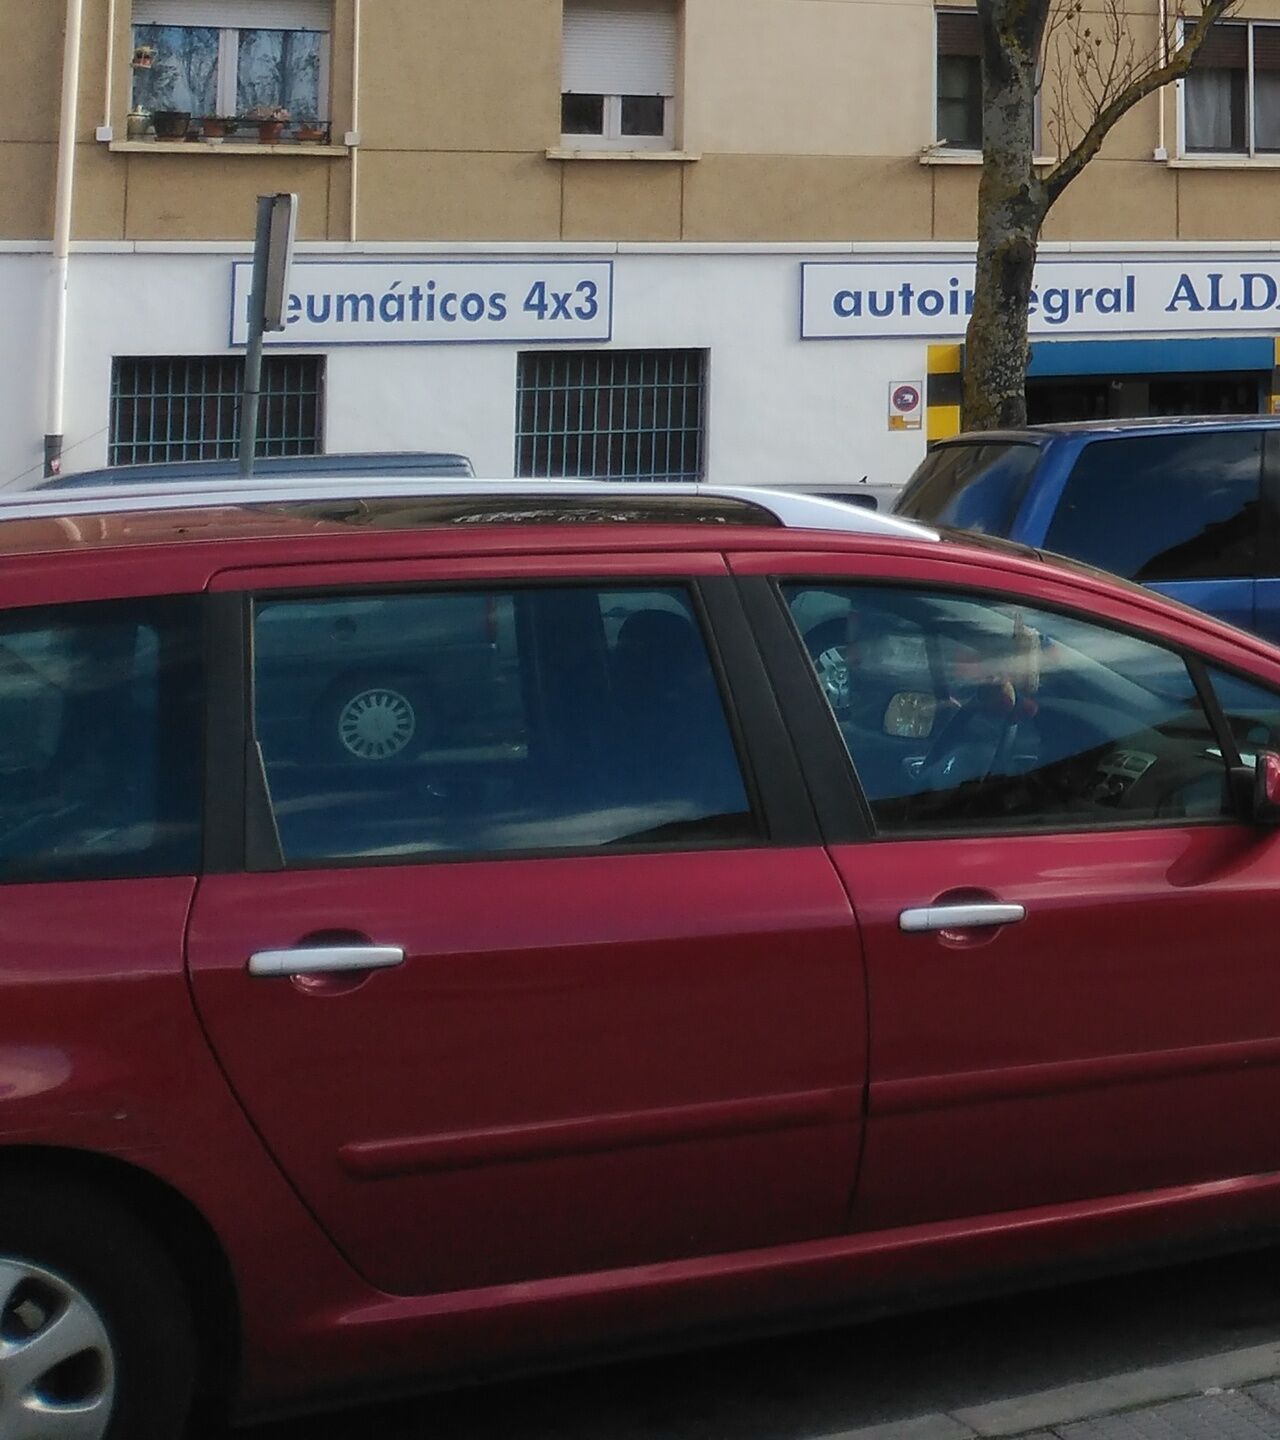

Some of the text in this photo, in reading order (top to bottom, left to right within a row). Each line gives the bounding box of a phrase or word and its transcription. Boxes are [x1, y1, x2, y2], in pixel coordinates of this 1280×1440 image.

[247, 280, 598, 324] eumáticos 4x3
[833, 276, 1135, 324] autoigral
